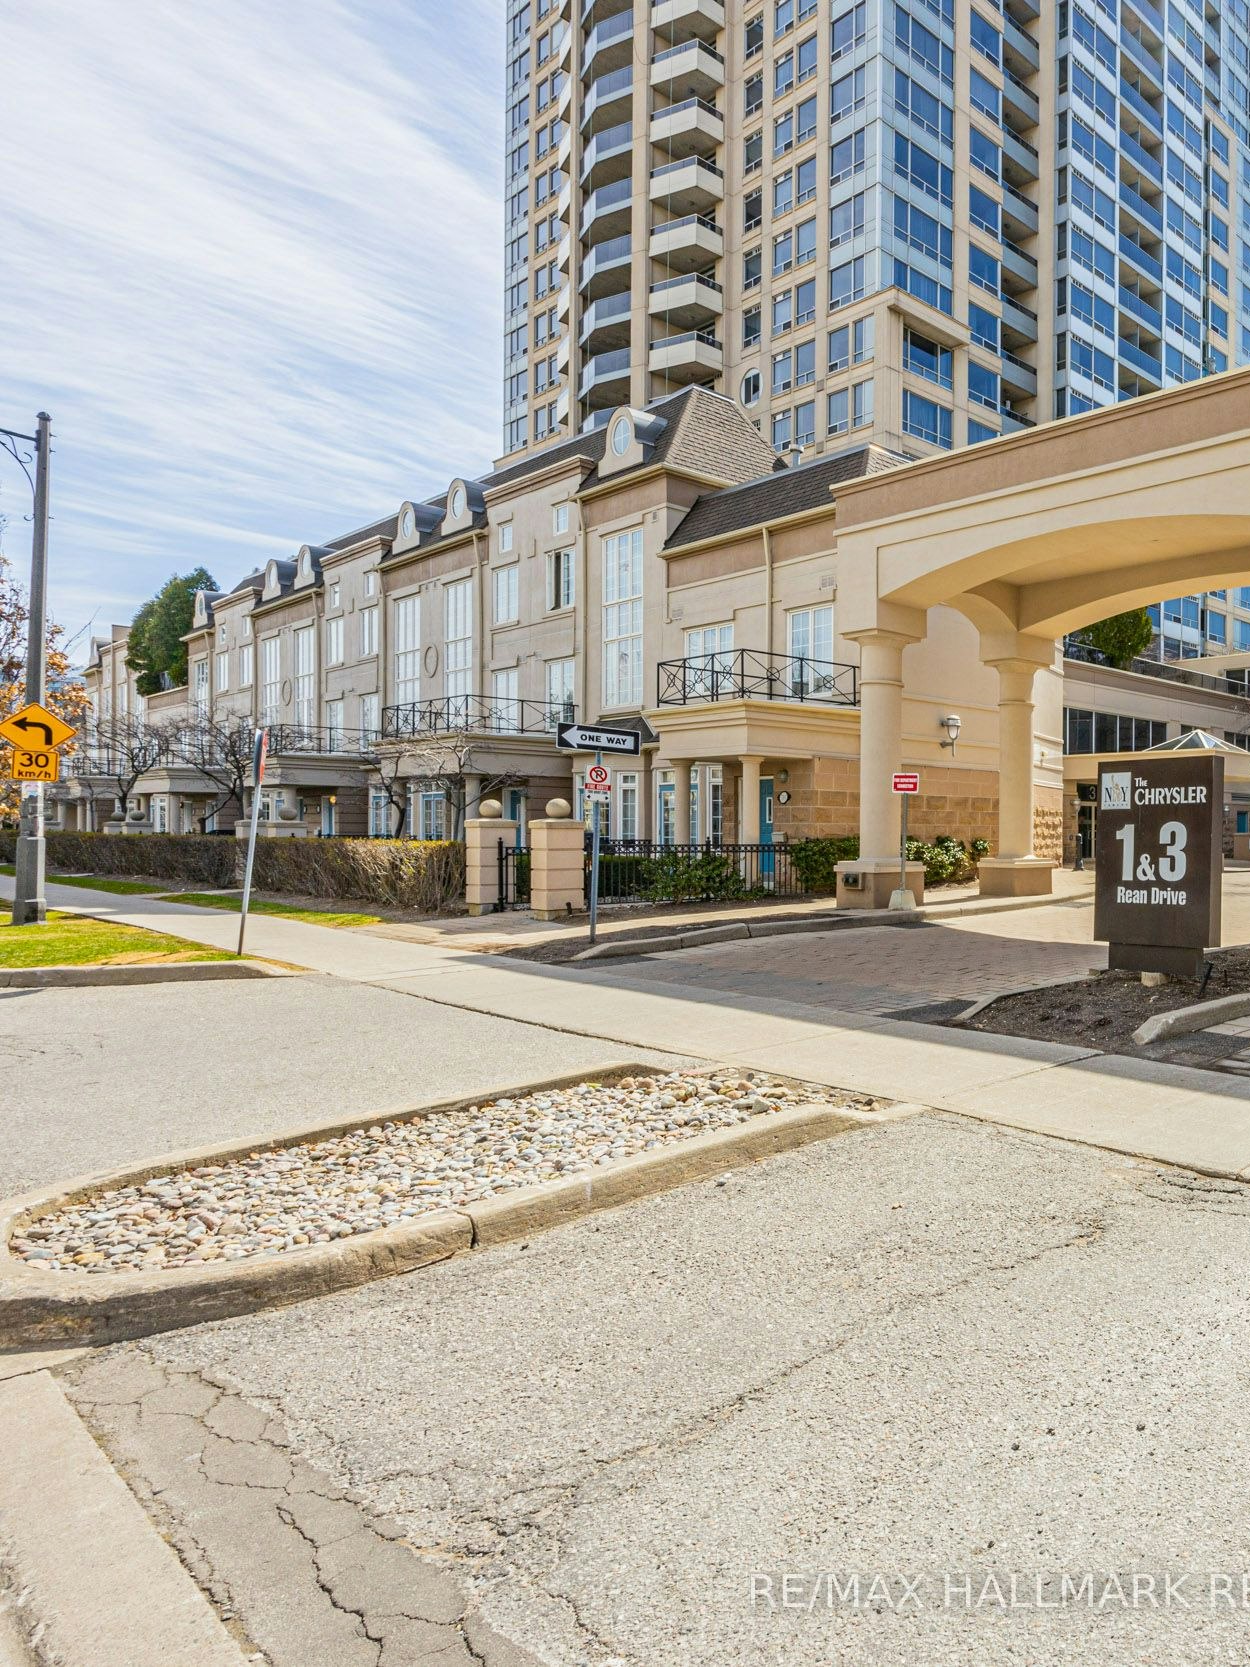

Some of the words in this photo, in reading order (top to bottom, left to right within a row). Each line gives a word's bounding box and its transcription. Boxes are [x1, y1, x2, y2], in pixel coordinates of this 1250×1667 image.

[580, 733, 602, 743] ONE
[606, 736, 627, 746] WAY
[20, 752, 49, 768] 30
[18, 769, 51, 779] km/h
[1089, 786, 1096, 800] 3
[1134, 786, 1207, 805] CHRYSLER
[1117, 886, 1148, 904] Rean
[1151, 887, 1187, 905] Drive
